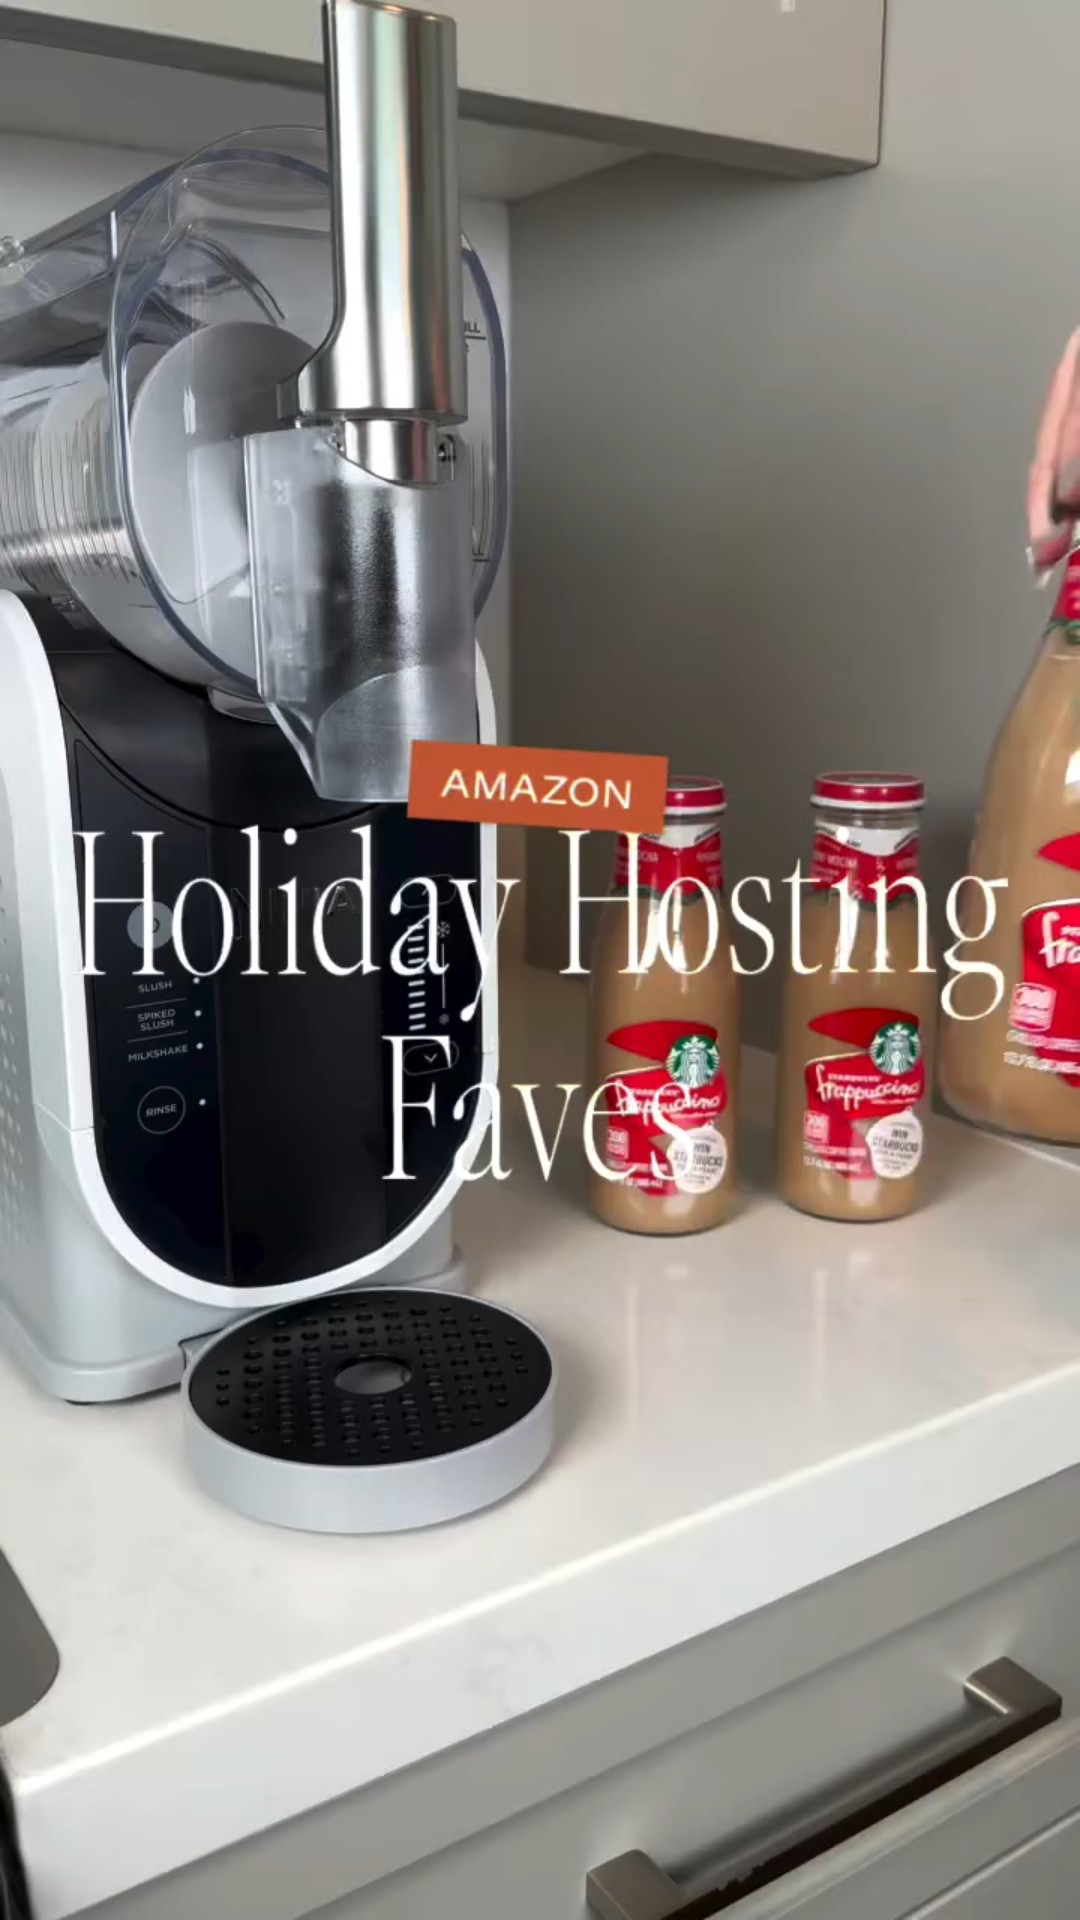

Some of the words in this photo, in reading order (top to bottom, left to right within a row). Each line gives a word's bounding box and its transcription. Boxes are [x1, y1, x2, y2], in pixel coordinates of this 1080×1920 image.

[464, 320, 481, 333] ILL
[137, 980, 173, 994] SLUSH
[137, 1008, 176, 1023] SPIKED
[140, 1018, 175, 1032] SLUSH
[128, 1043, 189, 1063] MILKSHAKE
[815, 1064, 920, 1111] frappuccino
[145, 1103, 178, 1118] RINSE
